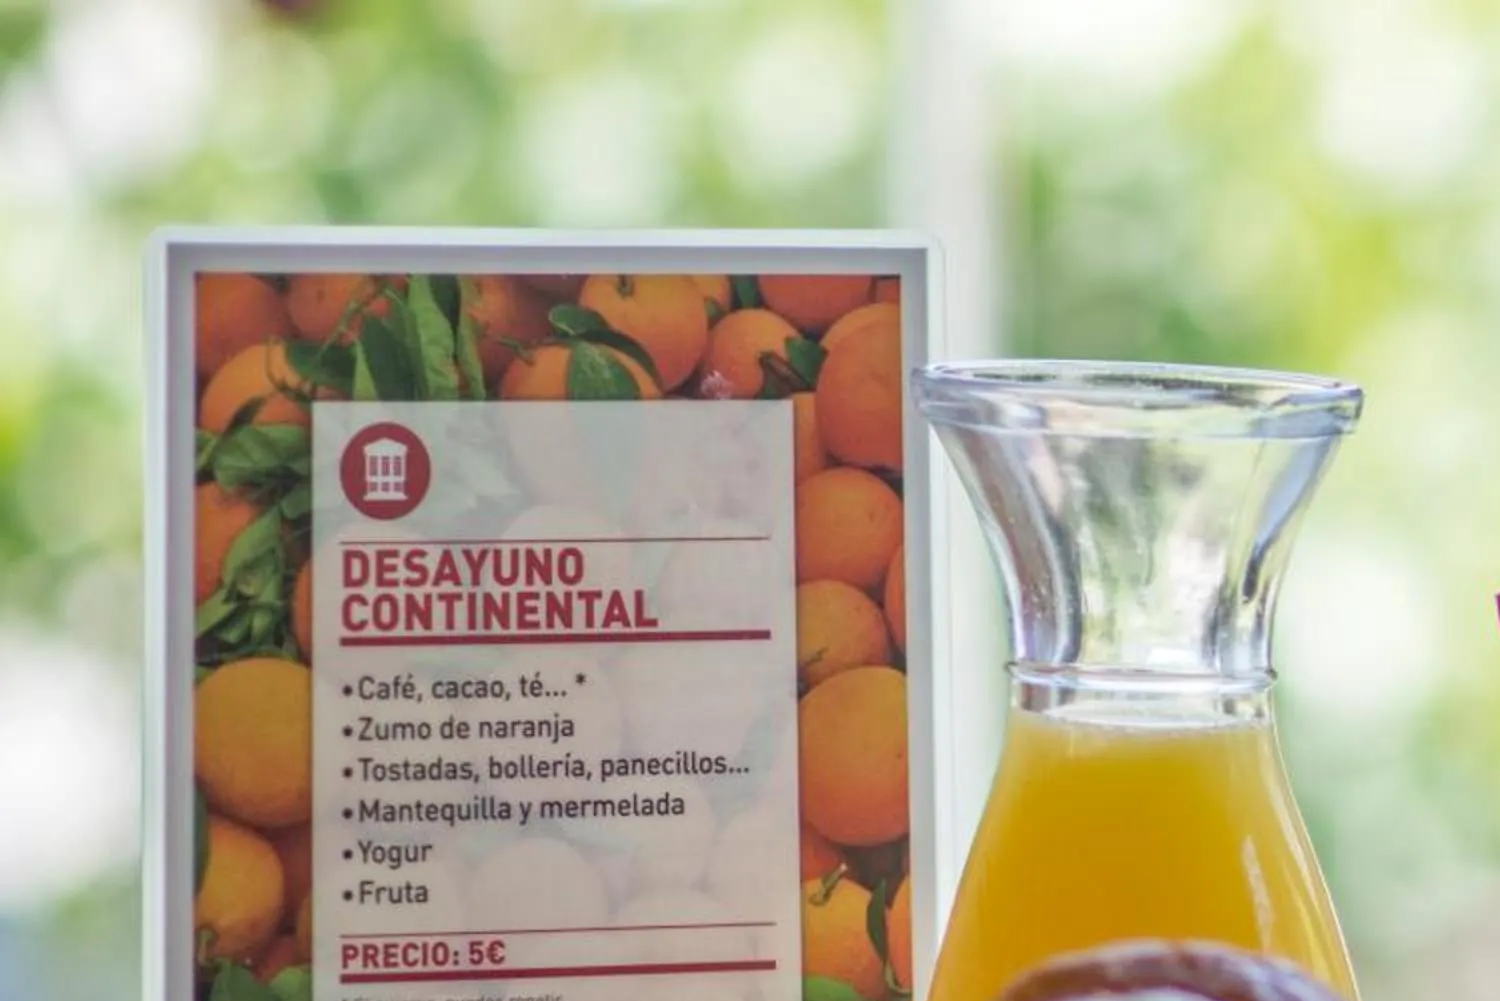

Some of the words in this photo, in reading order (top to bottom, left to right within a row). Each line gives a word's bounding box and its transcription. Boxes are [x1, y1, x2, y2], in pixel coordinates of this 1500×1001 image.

[342, 547, 585, 588] DESAYUNO
[341, 589, 659, 632] CONTINENTAL
[357, 674, 424, 702] Café,
[431, 676, 512, 701] cacao,
[519, 671, 568, 698] té...
[358, 716, 432, 742] Zumo
[439, 714, 471, 740] de
[478, 713, 575, 744] naranja
[357, 755, 481, 783] Tostadas,
[488, 752, 594, 781] bollería,
[600, 751, 751, 782] panecillos...
[358, 796, 512, 827] Mantequilla
[518, 800, 533, 826] y
[540, 792, 686, 819] mermelada
[357, 839, 434, 870] Yogur
[358, 879, 430, 904] Fruta
[341, 941, 460, 970] PRECIO:
[468, 940, 507, 966] 5€
